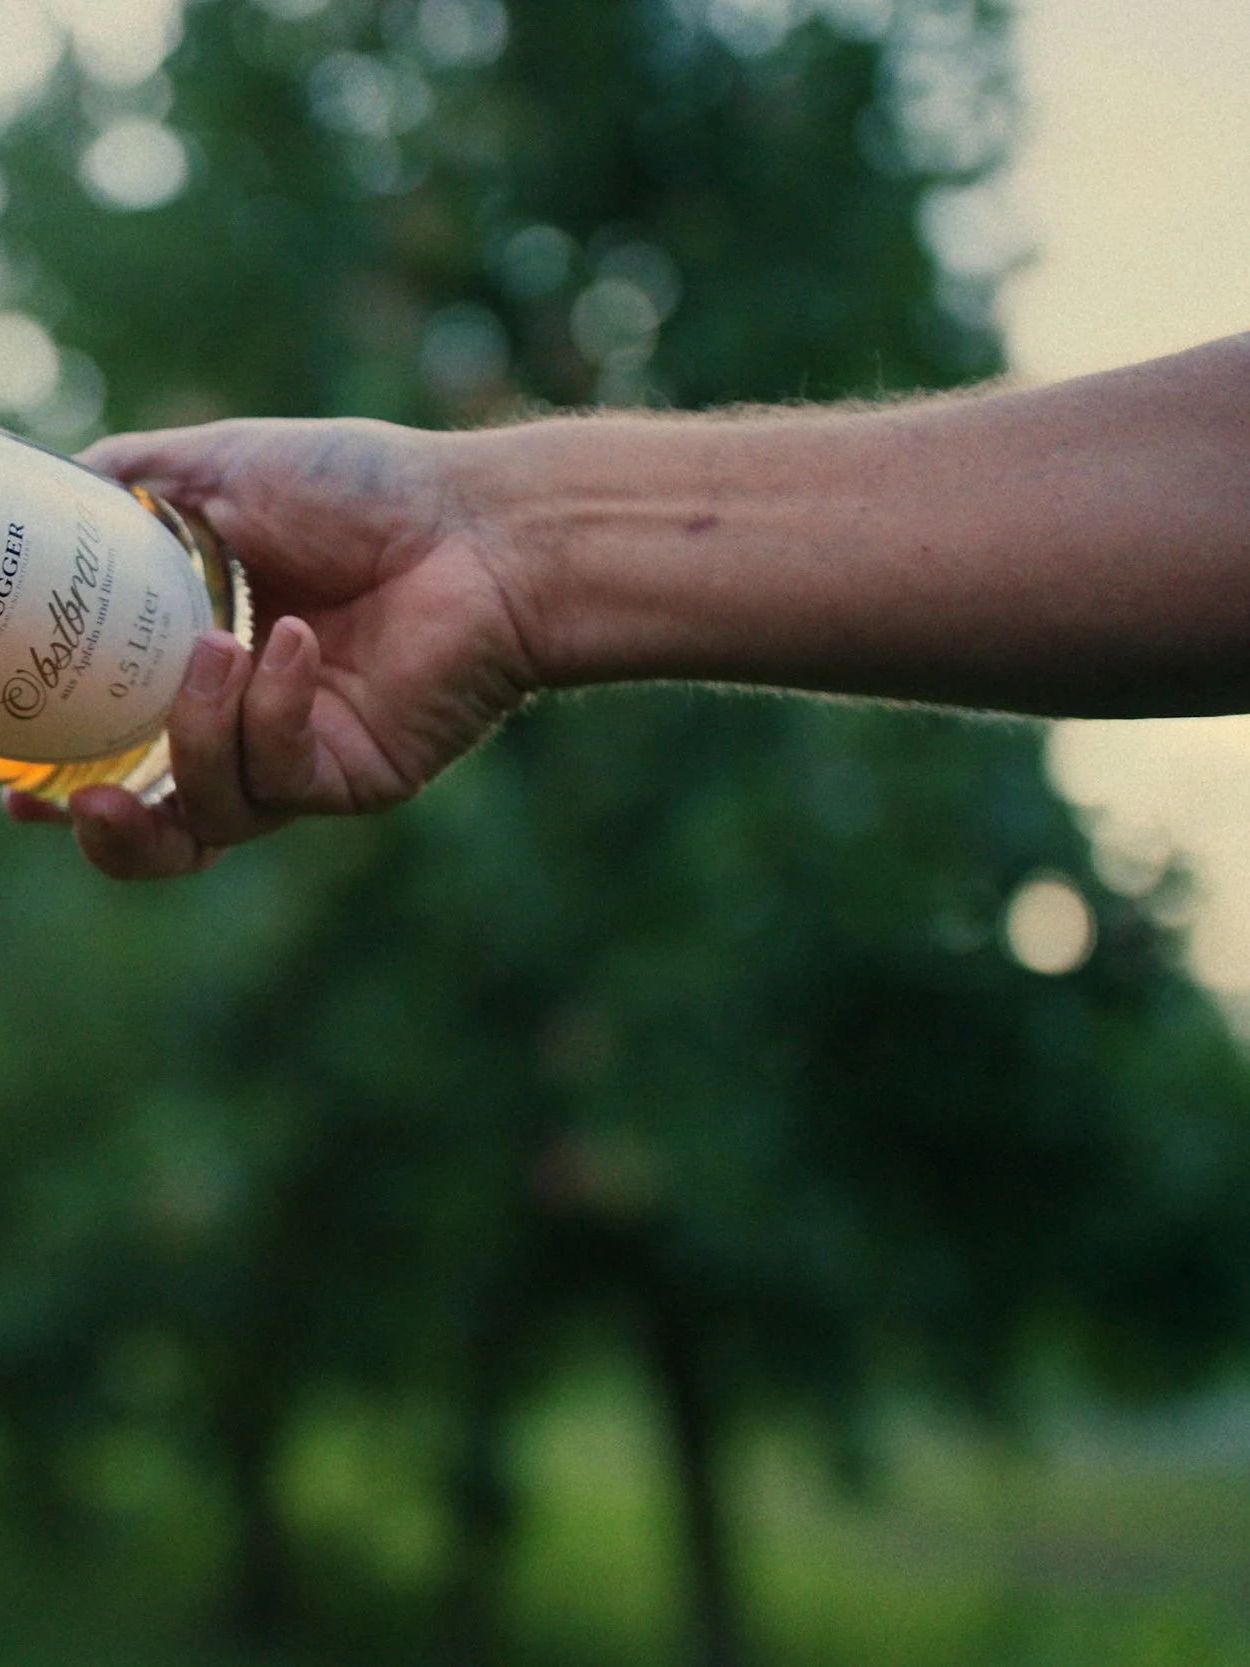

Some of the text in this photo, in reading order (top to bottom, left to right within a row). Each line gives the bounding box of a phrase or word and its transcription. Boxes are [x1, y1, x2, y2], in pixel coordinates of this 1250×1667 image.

[60, 679, 77, 701] aus
[96, 597, 110, 626] und
[108, 660, 139, 699] 0,5
[127, 586, 159, 653] Liter
